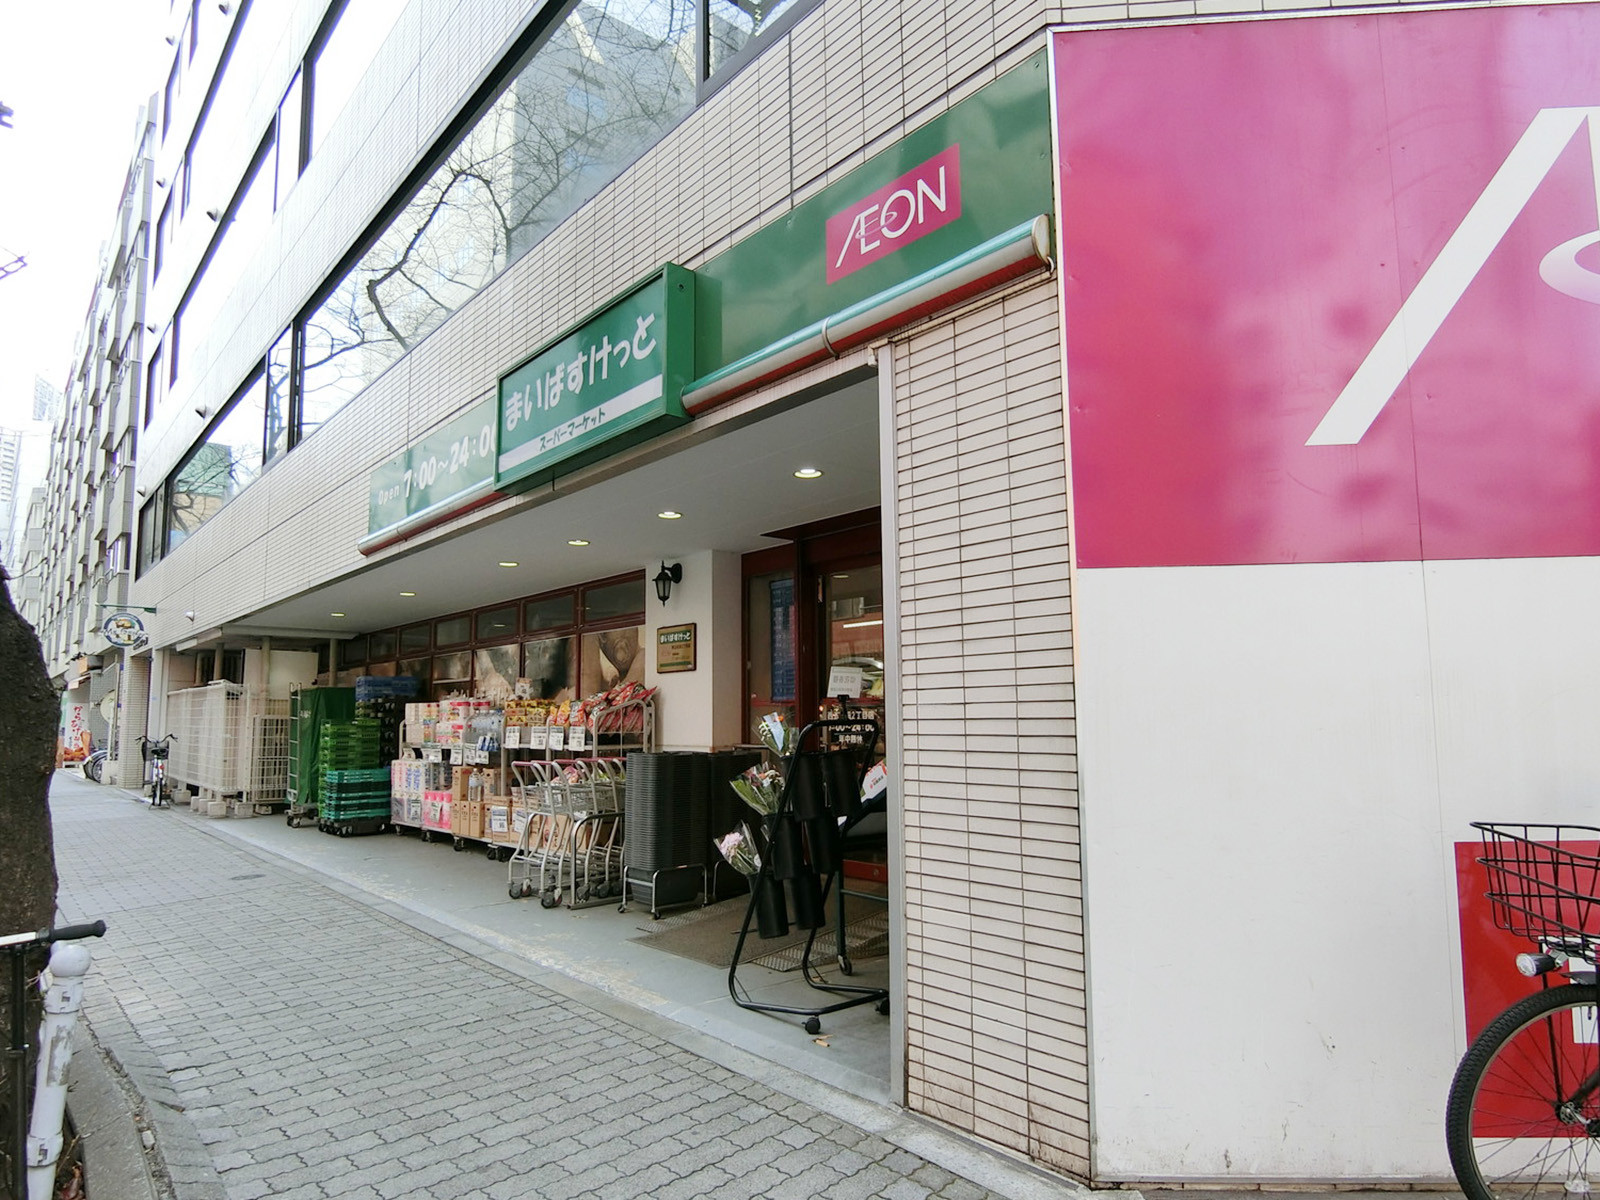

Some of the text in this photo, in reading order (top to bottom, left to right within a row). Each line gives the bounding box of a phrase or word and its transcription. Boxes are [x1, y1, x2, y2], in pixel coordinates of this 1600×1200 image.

[506, 313, 657, 431] まいばすけっと
[539, 407, 605, 451] スーパーマーケット
[378, 485, 400, 505] Open
